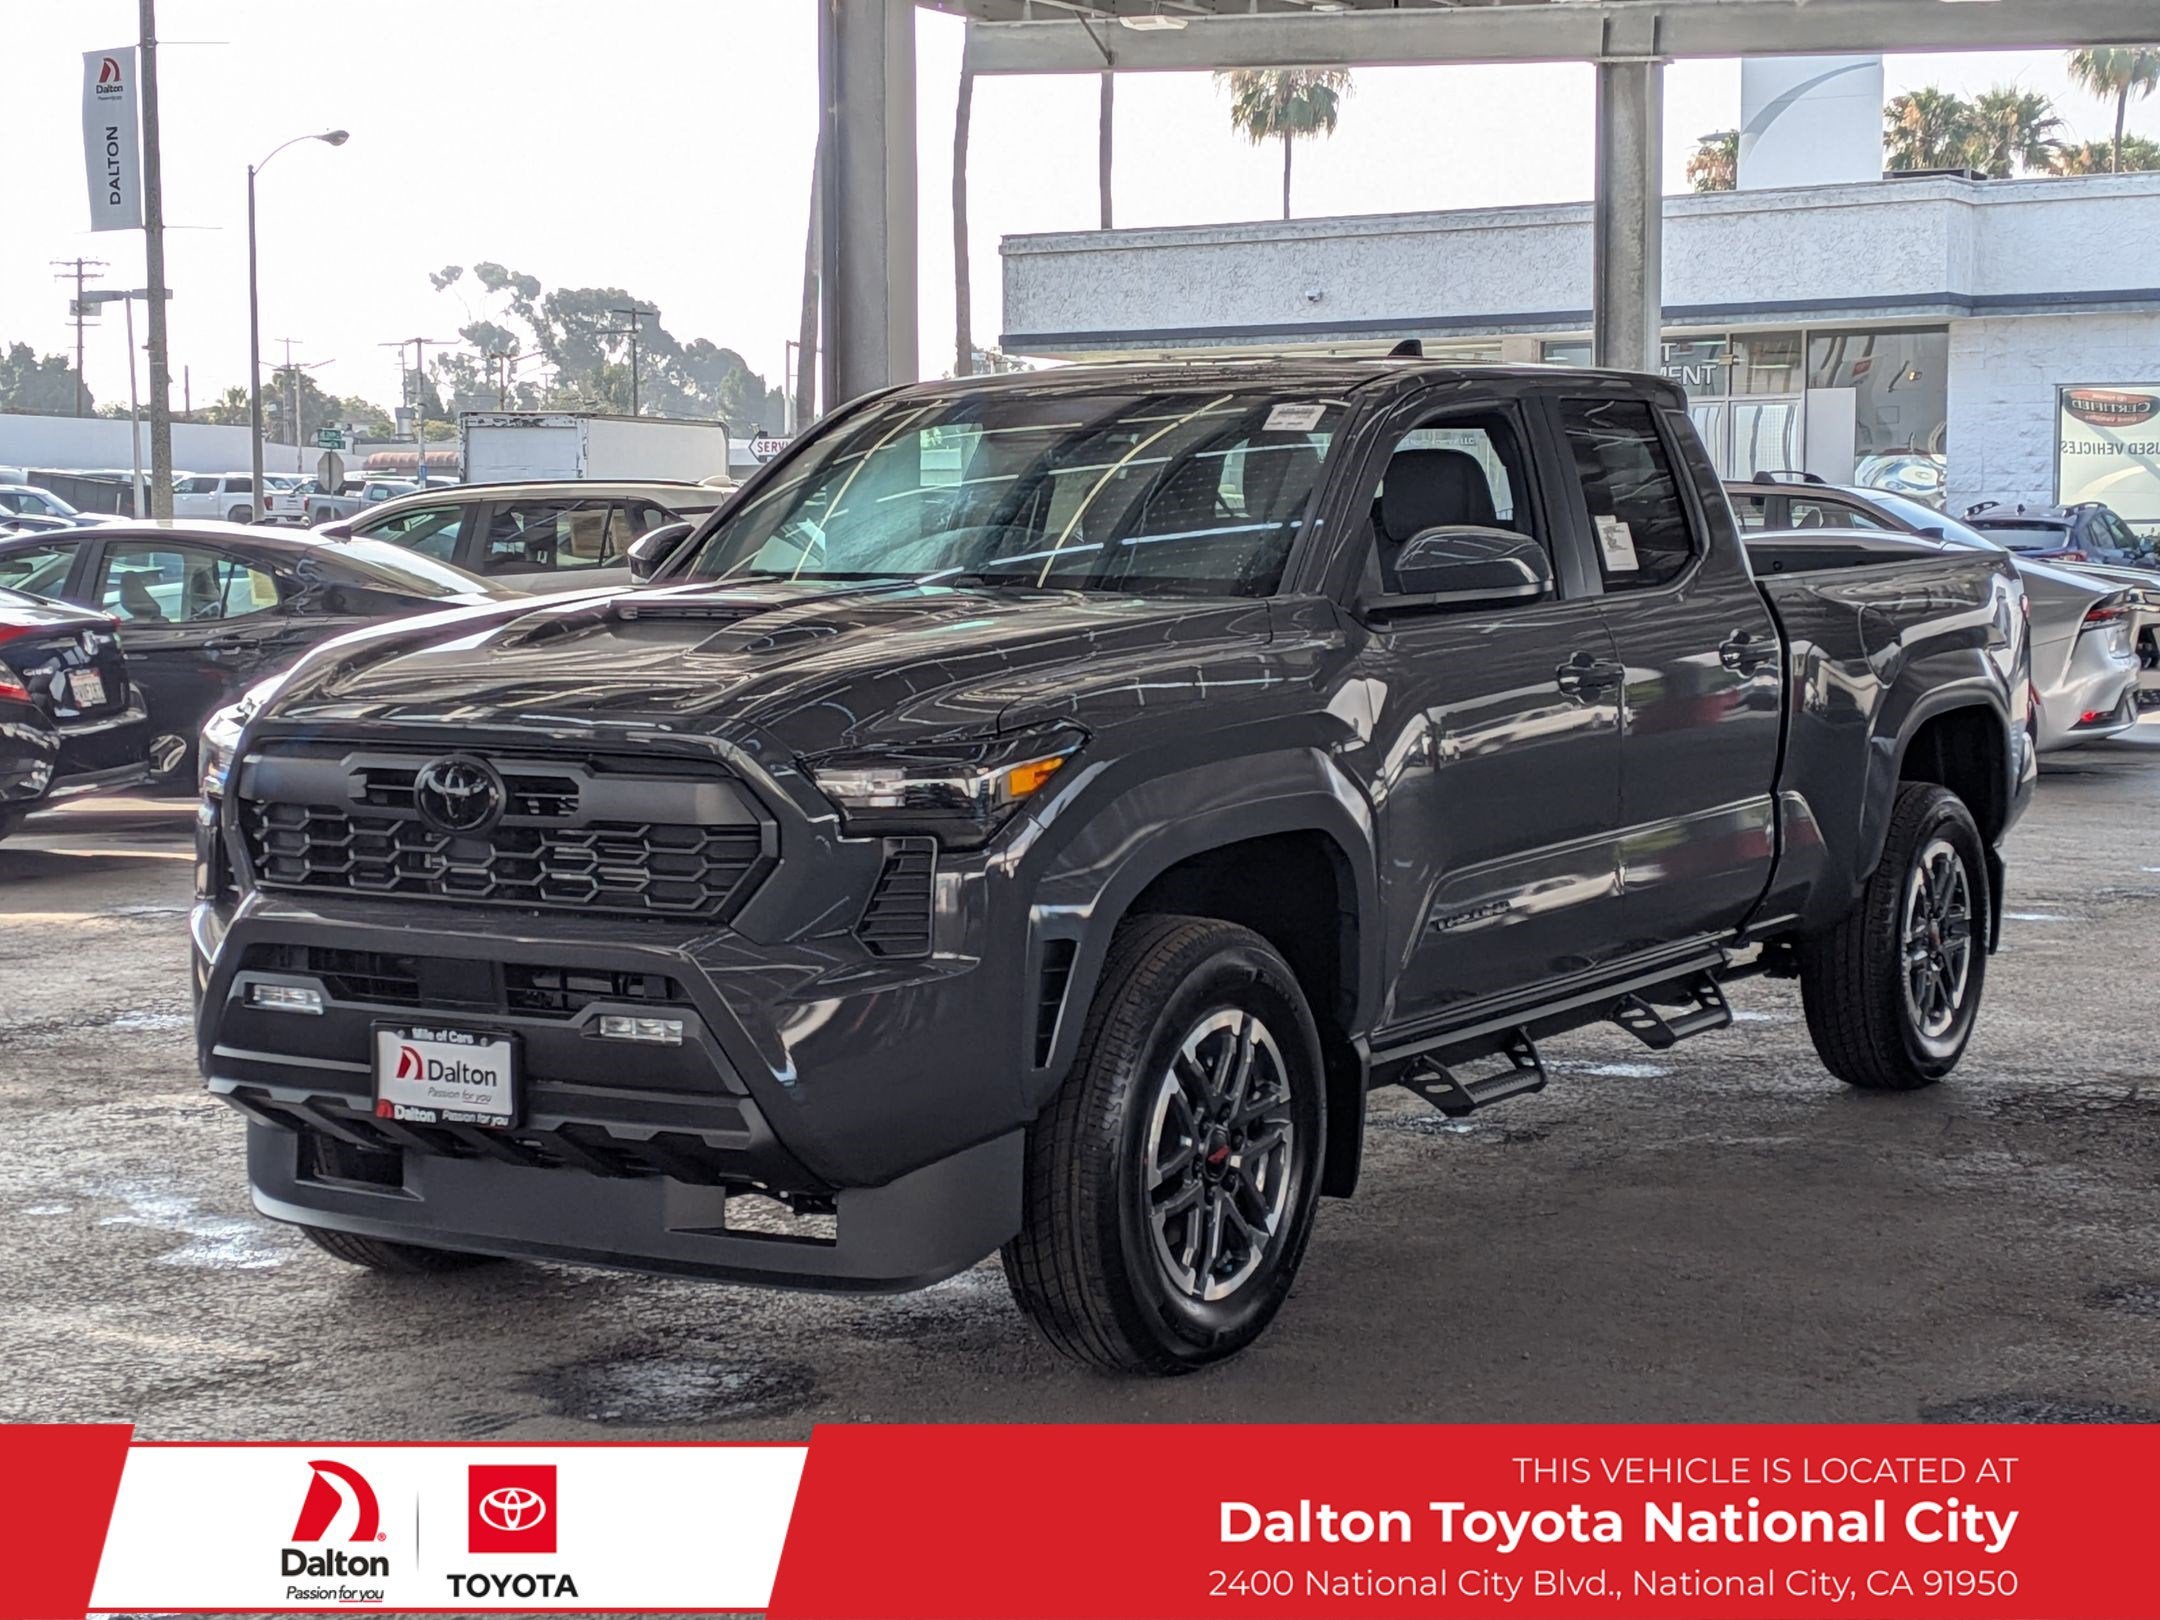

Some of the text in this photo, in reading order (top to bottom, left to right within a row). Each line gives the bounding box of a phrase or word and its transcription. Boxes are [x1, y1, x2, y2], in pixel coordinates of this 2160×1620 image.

[96, 84, 123, 94] Dalton
[105, 126, 121, 205] DALTON
[412, 1027, 474, 1044] Mile of Cars
[428, 1059, 497, 1087] Dalton
[428, 1087, 493, 1103] Passion for you
[394, 1105, 437, 1123] Dalton
[442, 1109, 509, 1127] Passion for you
